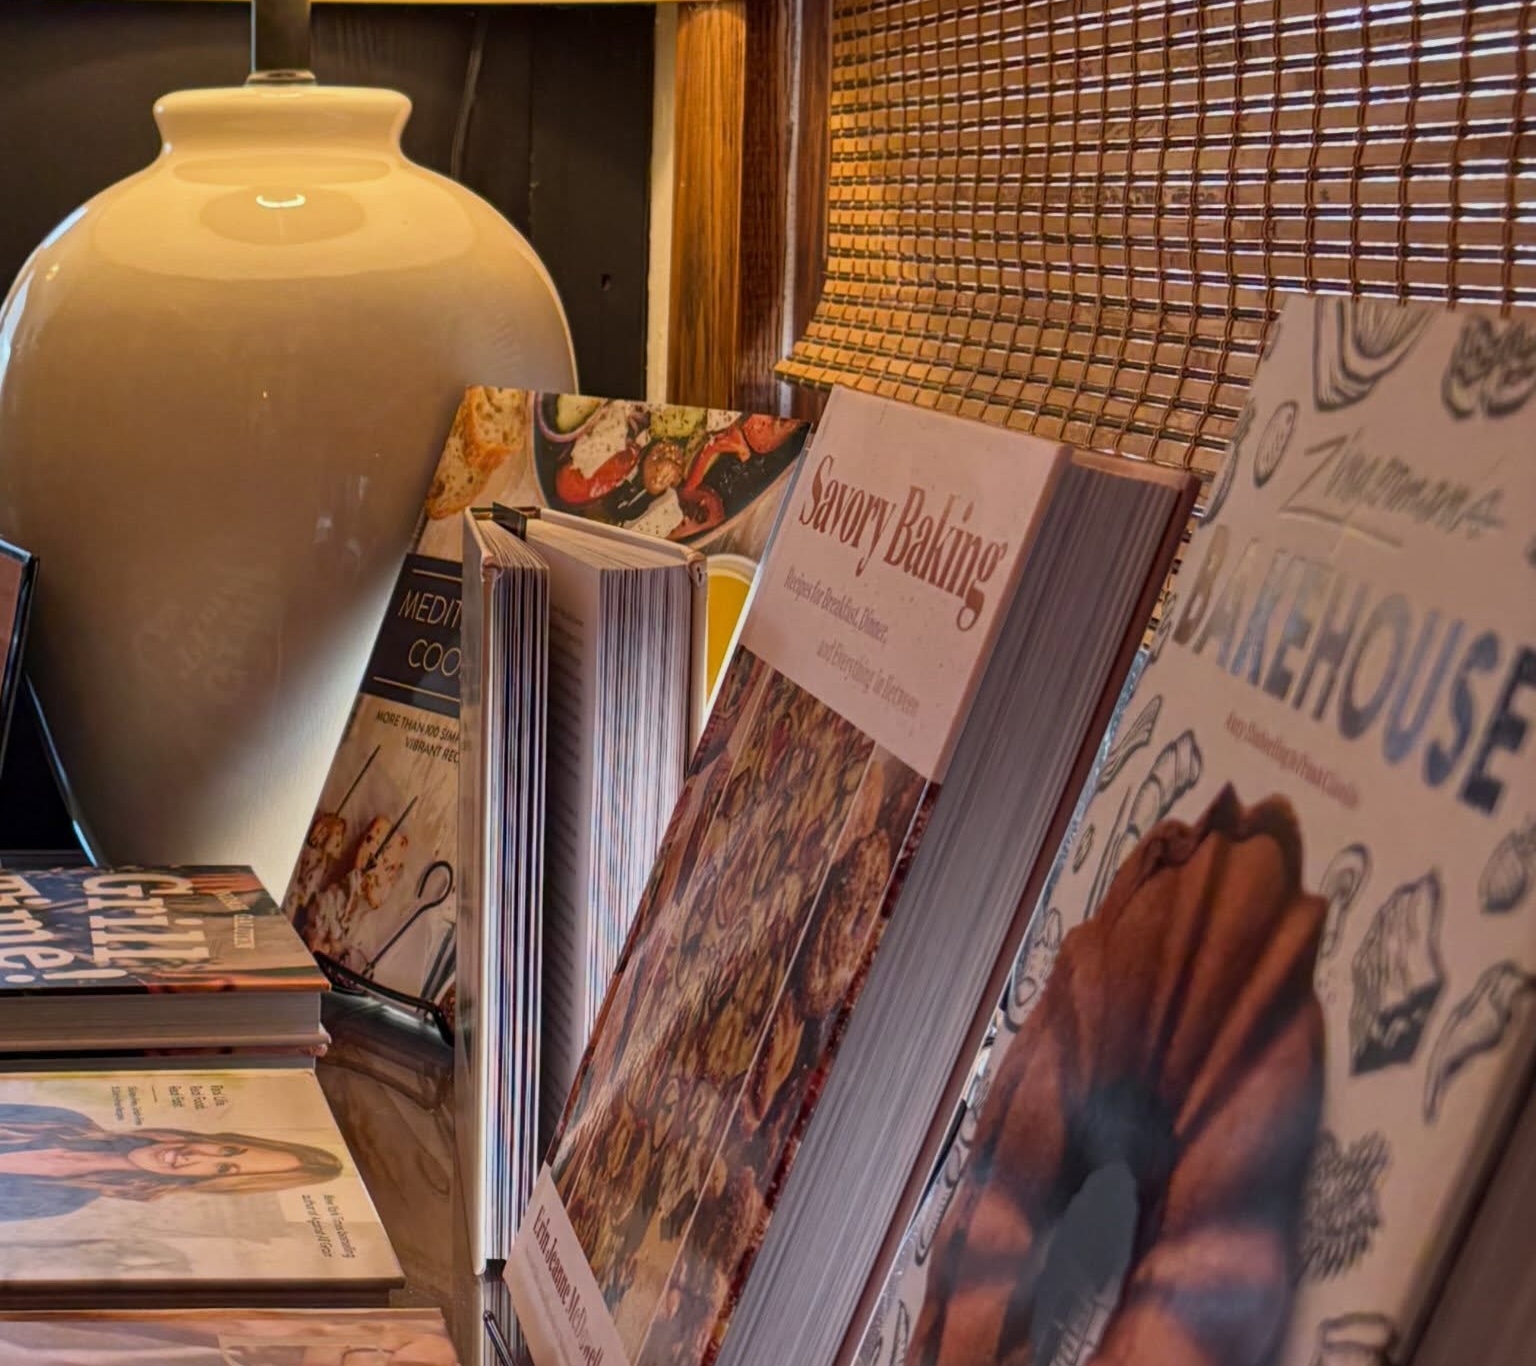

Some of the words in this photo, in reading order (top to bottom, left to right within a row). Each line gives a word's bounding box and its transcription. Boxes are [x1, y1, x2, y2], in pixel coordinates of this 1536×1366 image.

[799, 455, 897, 578] Savory
[883, 485, 1009, 632] Baking
[1173, 524, 1536, 817] BAKEHOUSE
[376, 709, 401, 727] MORE
[401, 716, 425, 734] THAN
[405, 738, 442, 758] VIBRANT
[83, 872, 211, 963] Grill
[533, 1205, 551, 1248] Erin
[545, 1237, 571, 1305] Jeanne
